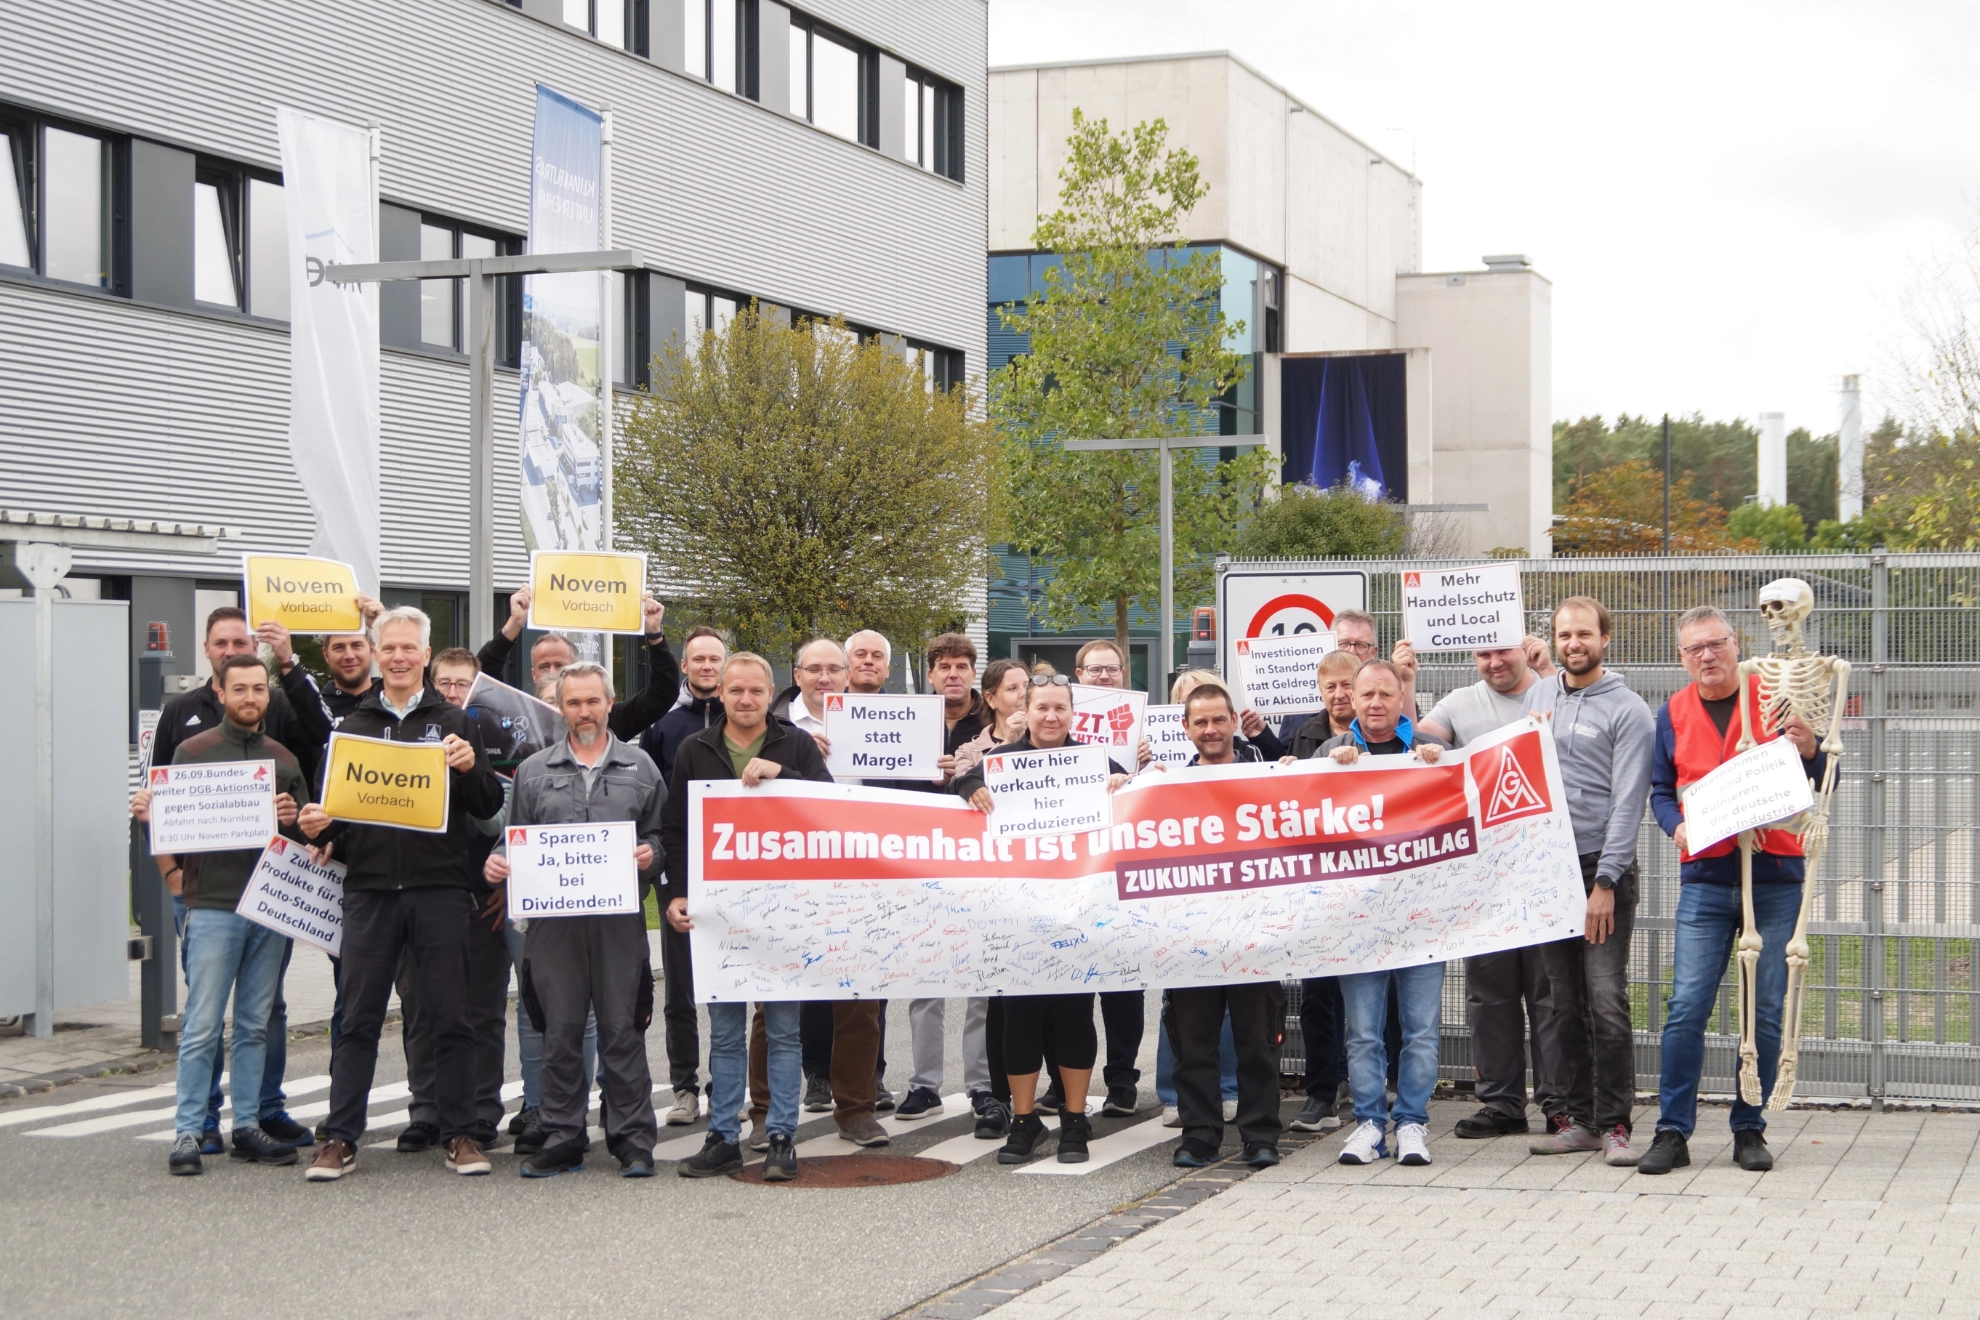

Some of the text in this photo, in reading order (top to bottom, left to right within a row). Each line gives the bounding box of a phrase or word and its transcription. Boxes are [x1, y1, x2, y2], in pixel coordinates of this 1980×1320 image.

[267, 576, 343, 594] Novem
[551, 574, 626, 594] Novem
[1442, 573, 1481, 587] Mehr
[281, 601, 332, 612] Vorbach
[562, 600, 613, 612] Vorbach
[1408, 591, 1516, 608] Handelsschutz
[1427, 611, 1500, 627] und Local
[1432, 631, 1497, 646] Content!
[1252, 646, 1323, 659] Investitionen
[1255, 666, 1265, 674] in
[1247, 678, 1319, 691] statt Geldreg
[1255, 697, 1269, 706] für
[851, 706, 915, 720] Mensch
[865, 732, 901, 743] statt
[853, 753, 912, 770] Marge!
[1012, 754, 1079, 770] Wer hier
[346, 762, 430, 788] Novem
[1690, 749, 1769, 796] Unternehmen
[1720, 759, 1786, 792] und Politik
[154, 783, 270, 796] weiter DGB-Aktionstag
[991, 774, 1104, 793] verkauft, muss
[165, 799, 260, 814] gegen Sozialabbau
[357, 792, 414, 808] Vorbach
[1034, 797, 1064, 809] hier
[1702, 784, 1759, 816] Ruinieren
[1710, 790, 1791, 826] die deutsche
[164, 814, 260, 826] Abfahrt nach Nürnberg
[711, 822, 1012, 862] Zusammenhalt
[1236, 794, 1384, 842] Stärke!
[1000, 811, 1100, 834] produzieren!
[1703, 804, 1795, 845] Auto-Industrie
[160, 834, 178, 842] 8:30
[199, 832, 228, 840] Novem
[231, 829, 269, 838] Parkplatz
[539, 830, 609, 848] Sparen ?
[538, 852, 607, 867] Ja, bitte:
[1124, 862, 1234, 893] ZUKUNFT
[1240, 853, 1313, 883] STATT
[1320, 828, 1470, 872] KAHLSCHLAG
[261, 861, 336, 902] Produkte für
[560, 873, 584, 886] bei
[260, 883, 343, 926] Auto-Standor
[522, 894, 622, 910] Dividenden!
[257, 901, 334, 942] Deutschland
